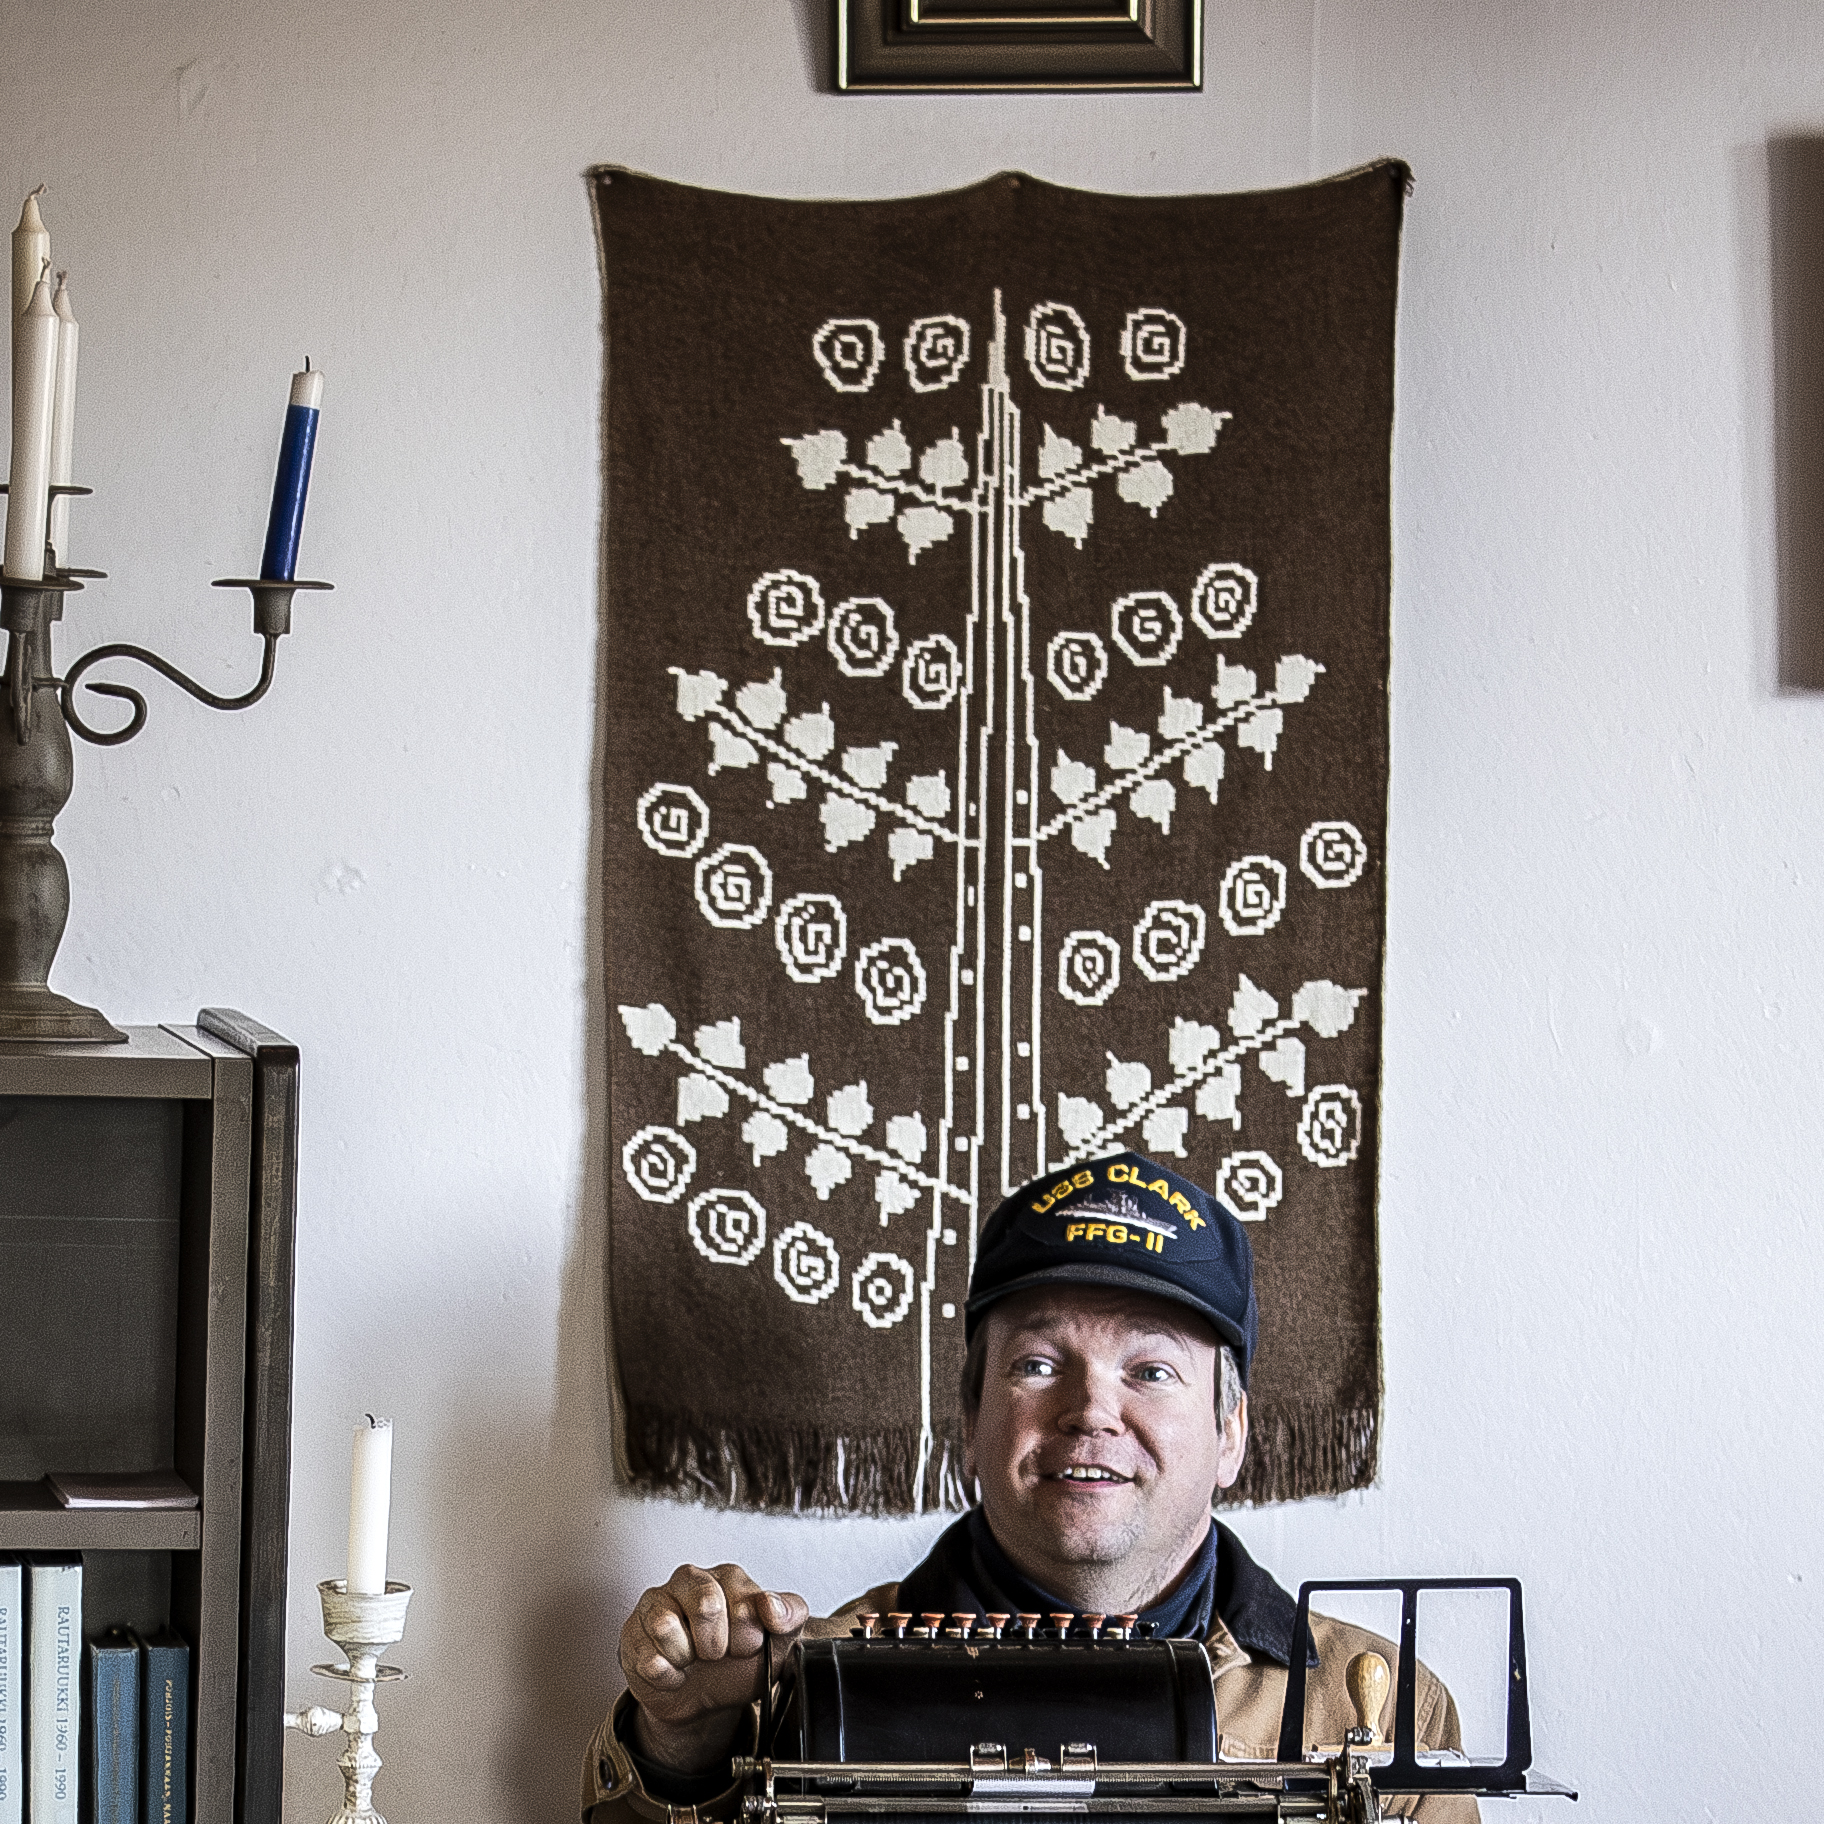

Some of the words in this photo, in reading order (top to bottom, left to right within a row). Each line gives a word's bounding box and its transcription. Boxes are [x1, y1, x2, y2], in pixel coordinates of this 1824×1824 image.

[1031, 1169, 1095, 1214] USS
[1106, 1163, 1207, 1231] CLARK
[56, 1606, 70, 1712] RAUTARUUKKI
[55, 1718, 69, 1751] 1960
[54, 1767, 67, 1800] 1990
